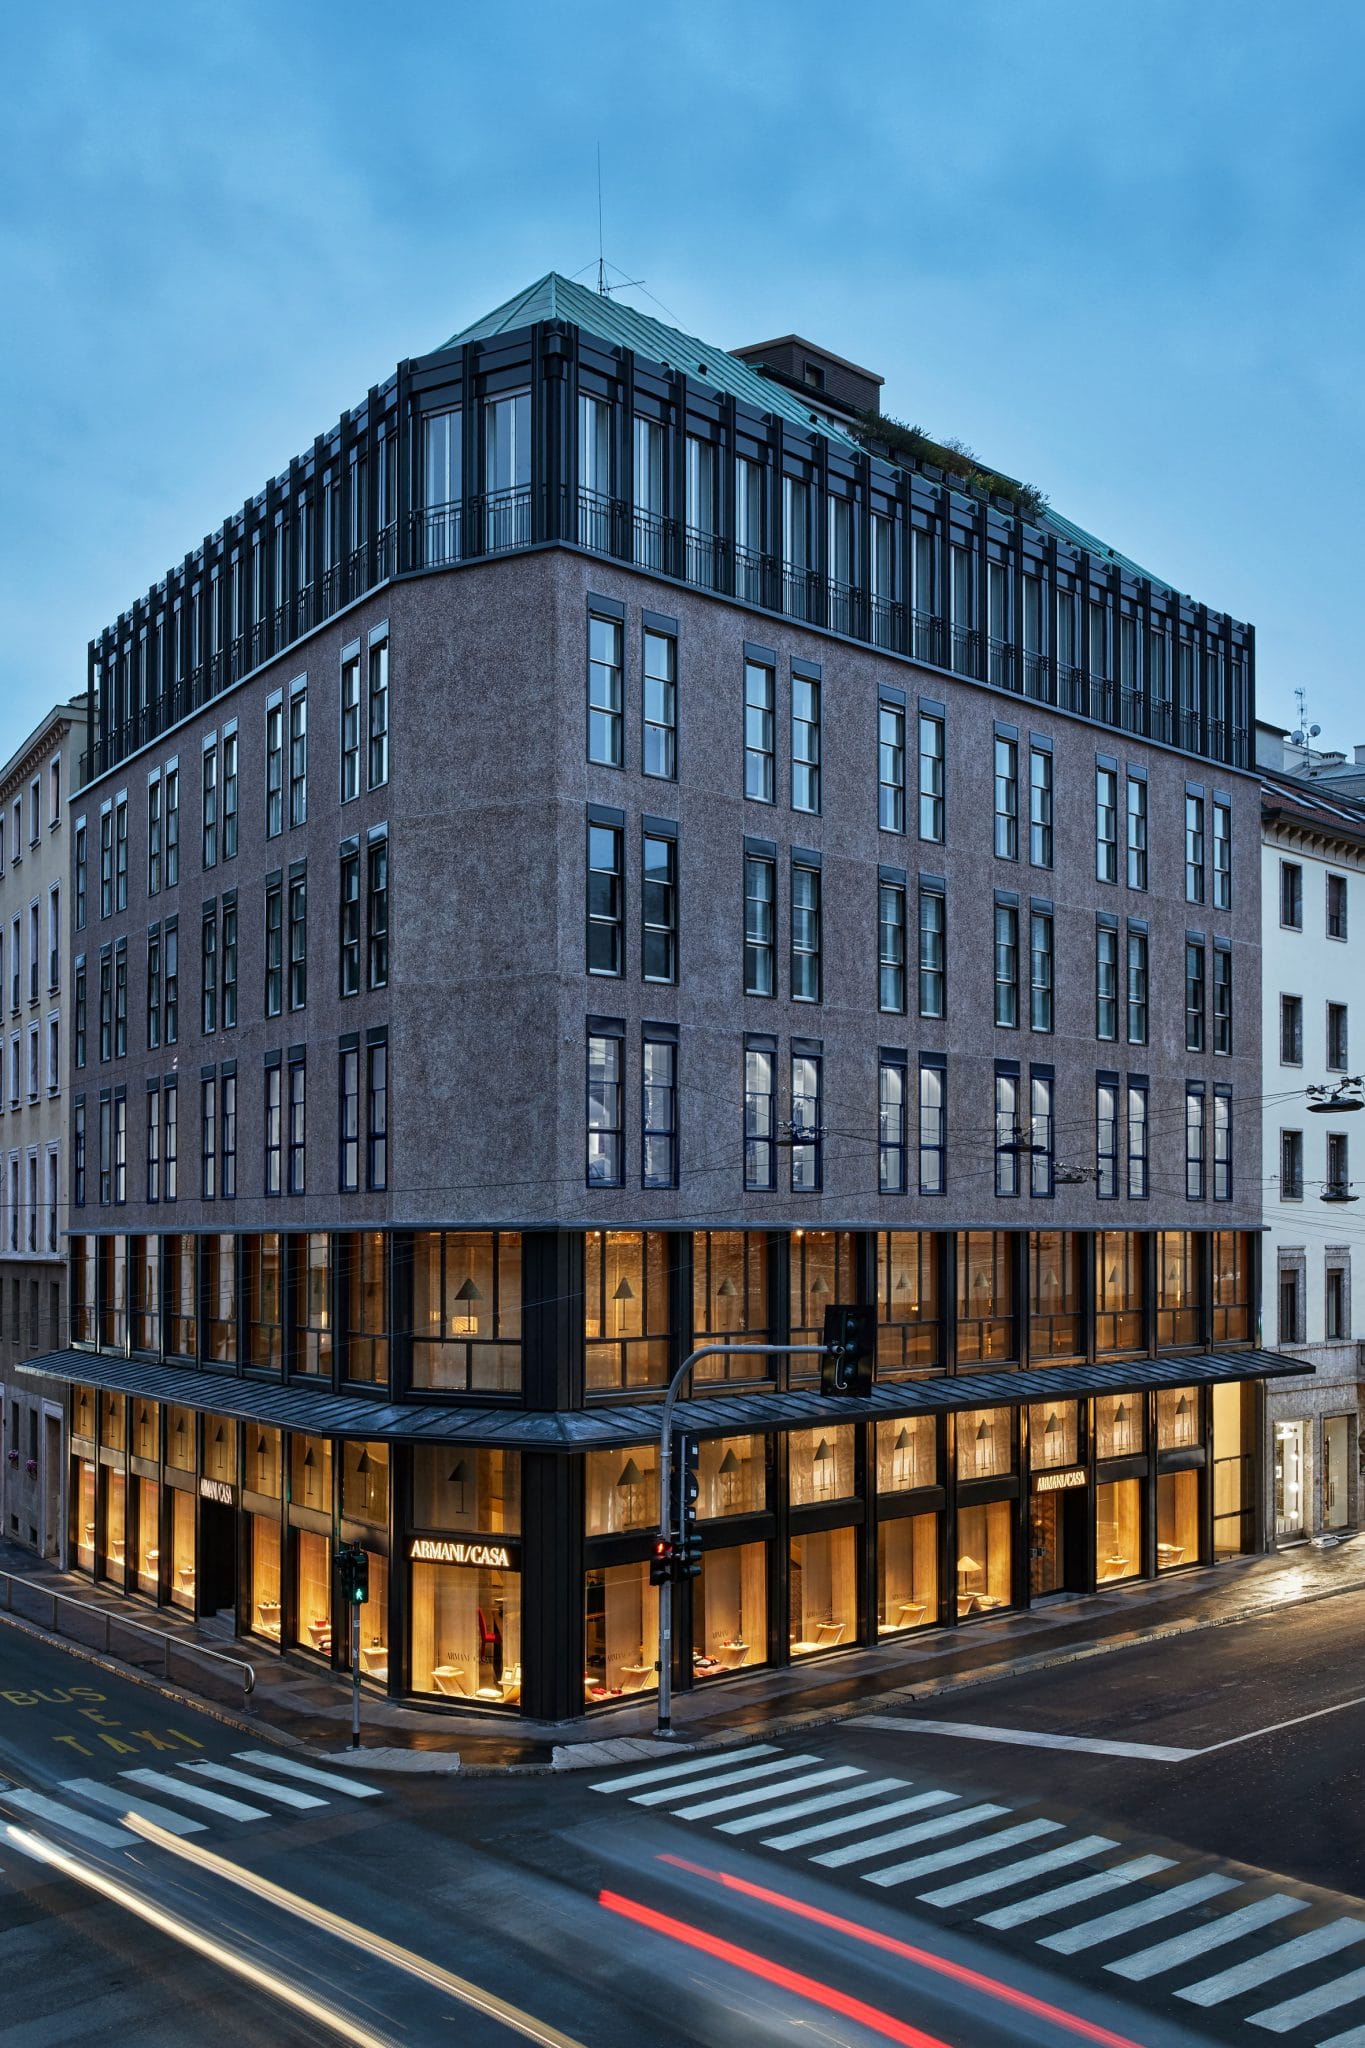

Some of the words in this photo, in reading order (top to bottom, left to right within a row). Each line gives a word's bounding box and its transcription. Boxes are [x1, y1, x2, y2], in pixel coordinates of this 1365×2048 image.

[410, 1539, 510, 1567] ARMANI/CASA
[0, 1687, 107, 1706] BUS
[77, 1708, 122, 1727] E
[51, 1728, 205, 1757] TAXI
